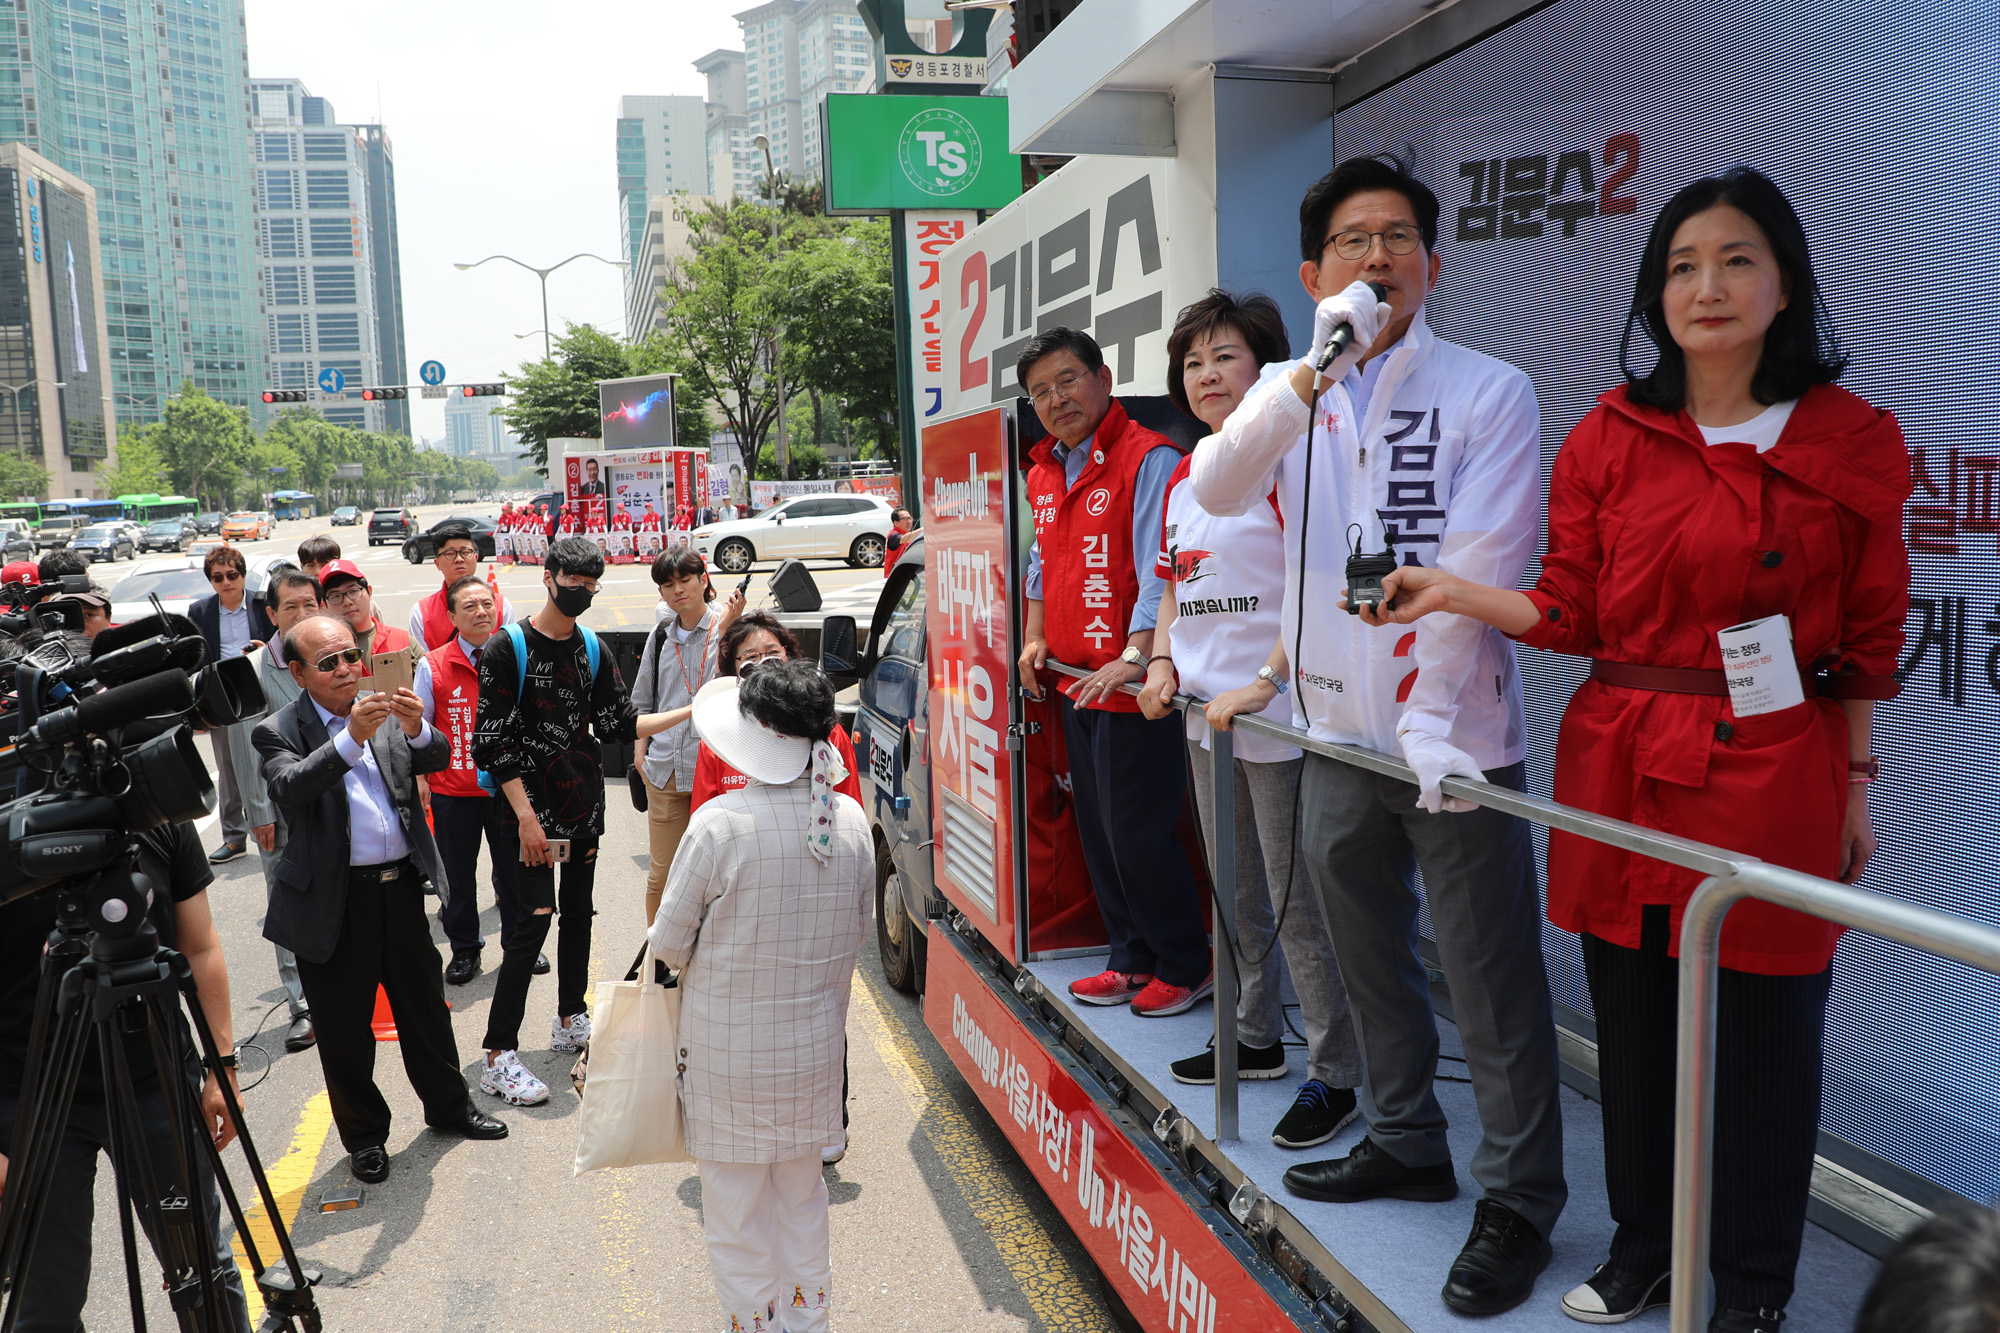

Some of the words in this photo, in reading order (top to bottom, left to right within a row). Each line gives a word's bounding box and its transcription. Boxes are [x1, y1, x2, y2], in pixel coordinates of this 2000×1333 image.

[915, 61, 985, 78] 영등포경찰서
[916, 131, 968, 177] TS
[636, 470, 654, 480] 변화를
[708, 478, 729, 496] 길형
[803, 483, 832, 493] 통일시대
[622, 492, 653, 507] 김춘수
[1036, 493, 1054, 506] 영포
[329, 560, 341, 572] 2
[22, 573, 31, 584] 2
[936, 546, 994, 649] 바꾸자
[1081, 533, 1113, 650] 김춘수
[1740, 641, 1761, 657] 정당
[535, 679, 553, 688] ART
[1304, 673, 1344, 693] 자유한국당
[449, 713, 464, 770] 구의원후보
[938, 658, 999, 821] 서울
[42, 844, 84, 856] SONY
[952, 992, 1000, 1089] Change
[999, 1047, 1073, 1184] 서울시장!
[1078, 1118, 1105, 1228] Up
[1106, 1179, 1217, 1333] 서울시민
